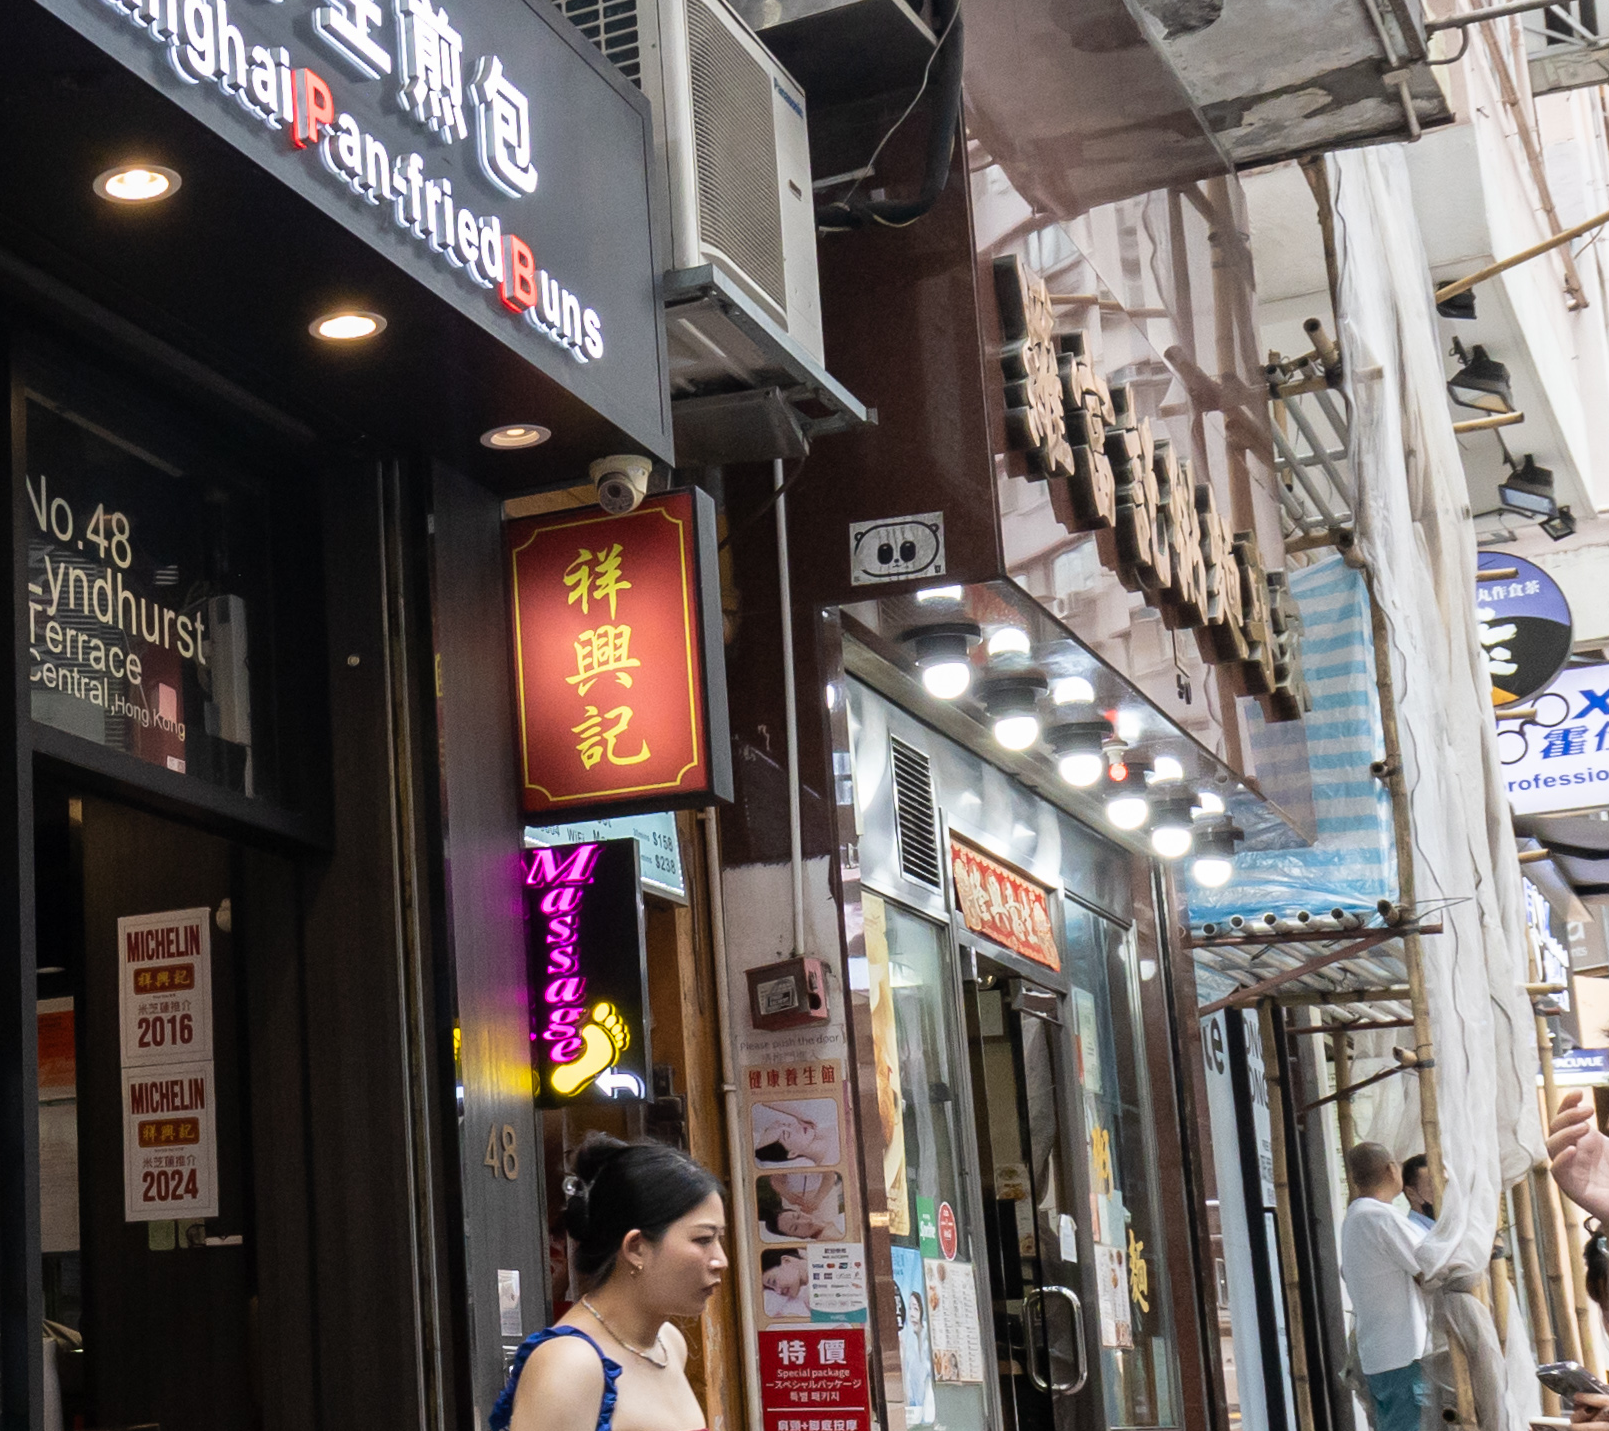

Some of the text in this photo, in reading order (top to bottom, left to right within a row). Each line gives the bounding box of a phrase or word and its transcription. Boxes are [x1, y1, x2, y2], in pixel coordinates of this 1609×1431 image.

[288, 66, 505, 302] Pan-fried
[500, 230, 606, 364] Buns
[29, 604, 142, 685] Terrace
[563, 543, 651, 771] 祥興記
[115, 694, 150, 727] Hong
[153, 704, 186, 741] Kong
[652, 831, 674, 852] $158
[655, 854, 677, 875] $238
[126, 923, 201, 963] MICHELIN
[526, 843, 600, 1063] Massage
[137, 968, 191, 990] 祥興記
[137, 1014, 194, 1049] 2016
[772, 1036, 796, 1050] push
[797, 1035, 815, 1045] the
[815, 1033, 839, 1044] door
[748, 1064, 836, 1090] 健康養生館
[130, 1077, 205, 1115] MICHELIN
[484, 1123, 519, 1181] 48
[142, 1168, 199, 1203] 2024
[778, 1339, 847, 1366] 特價
[777, 1368, 851, 1379] Special package
